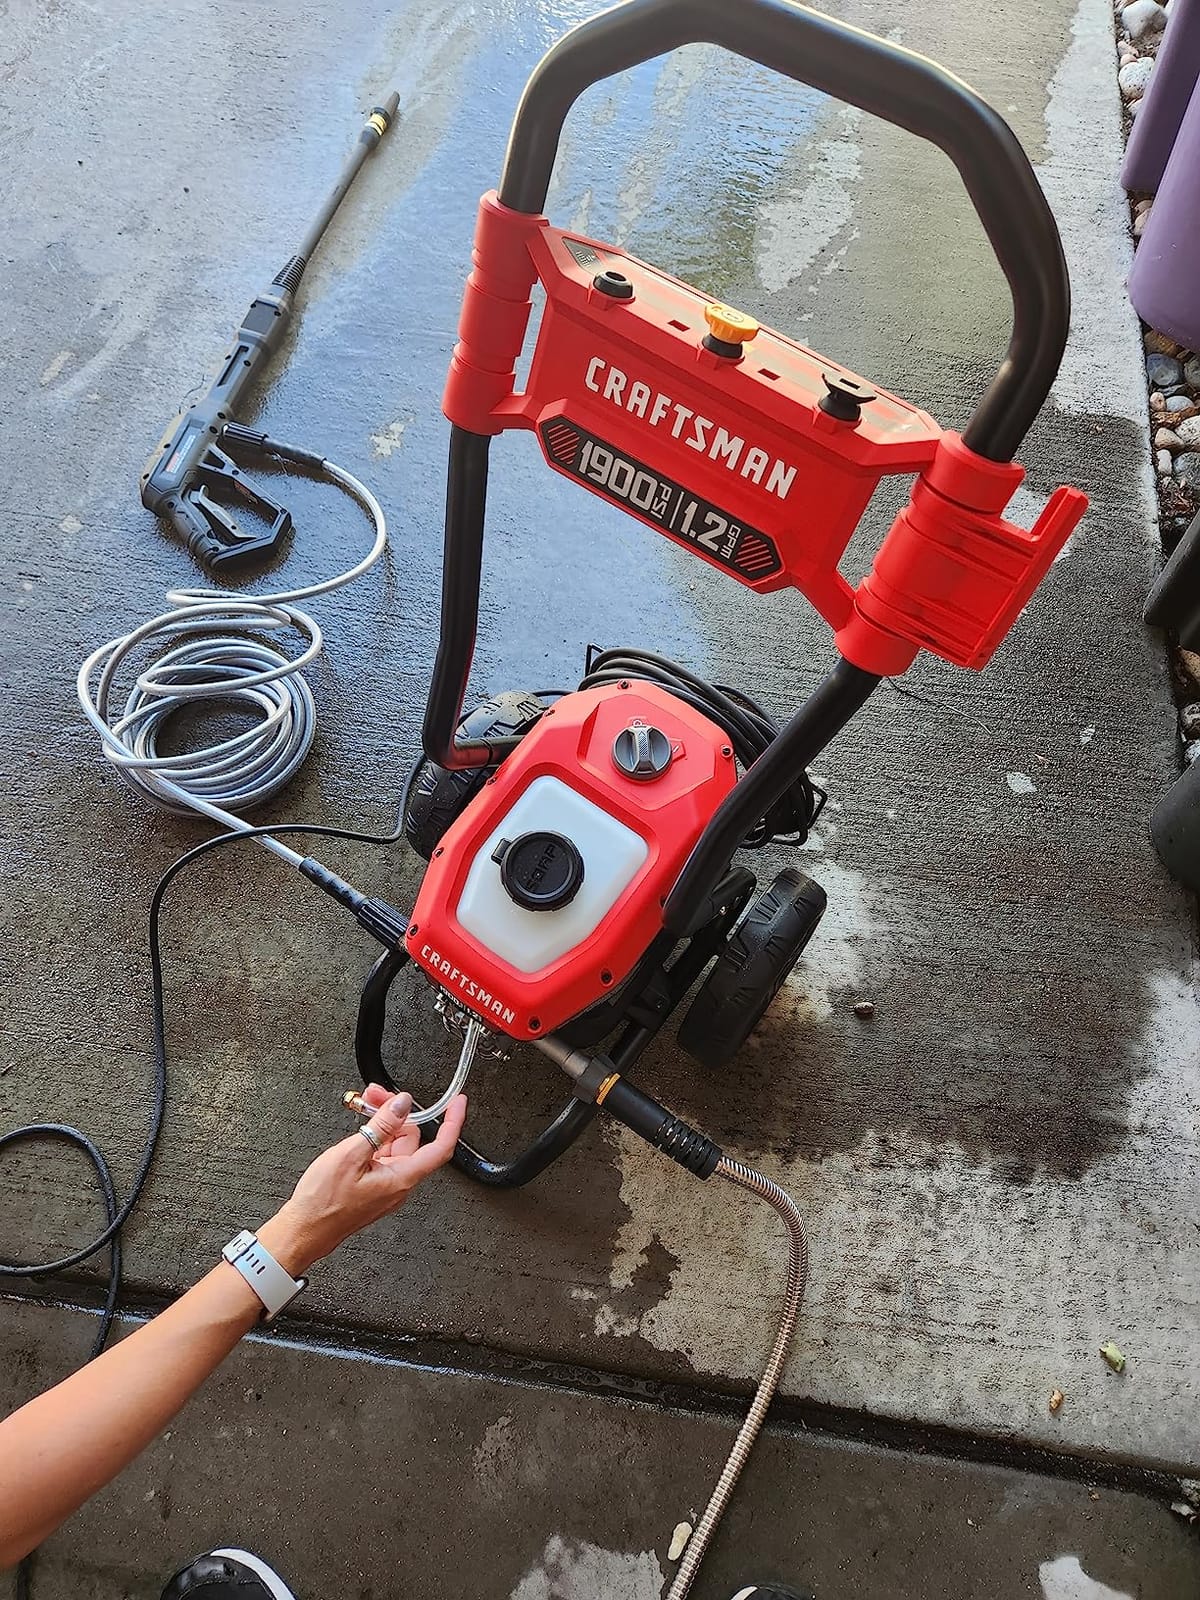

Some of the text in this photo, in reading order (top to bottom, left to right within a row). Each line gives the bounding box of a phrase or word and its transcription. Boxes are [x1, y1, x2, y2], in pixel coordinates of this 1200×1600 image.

[584, 355, 799, 500] CRAFTSMAN
[578, 440, 742, 559] 1900 PSI 1.2 GPM
[420, 944, 516, 1024] CRAFTSMAN
